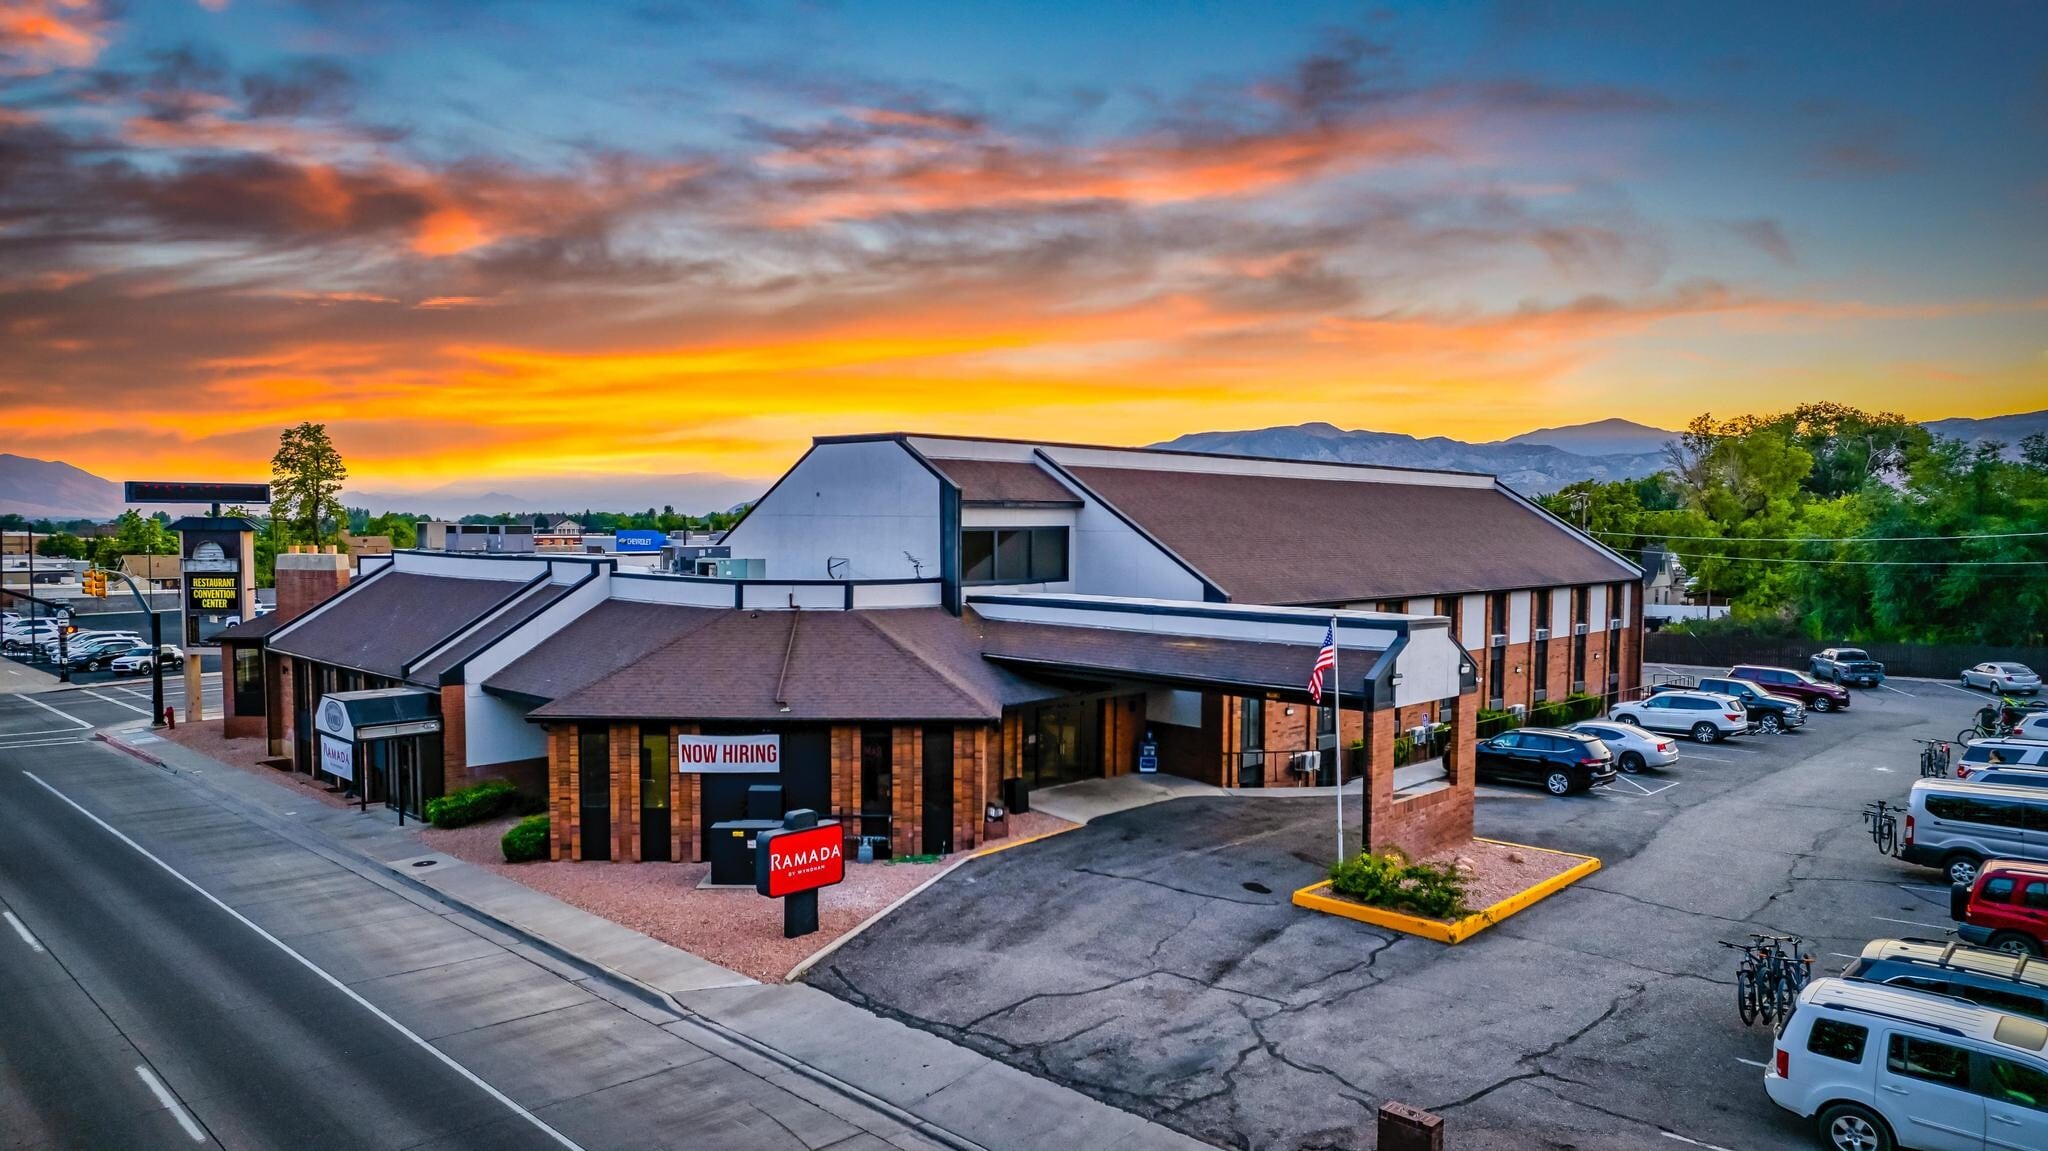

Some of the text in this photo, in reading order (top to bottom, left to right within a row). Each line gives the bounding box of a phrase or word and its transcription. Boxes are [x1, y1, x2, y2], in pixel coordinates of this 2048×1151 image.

[193, 578, 235, 587] RESTAURANT
[193, 590, 236, 599] CONVENTION
[202, 599, 227, 608] CENTER
[681, 744, 777, 763] NOW HIRING
[770, 844, 841, 872] RAMADA
[797, 864, 826, 875] WYNDHAM
